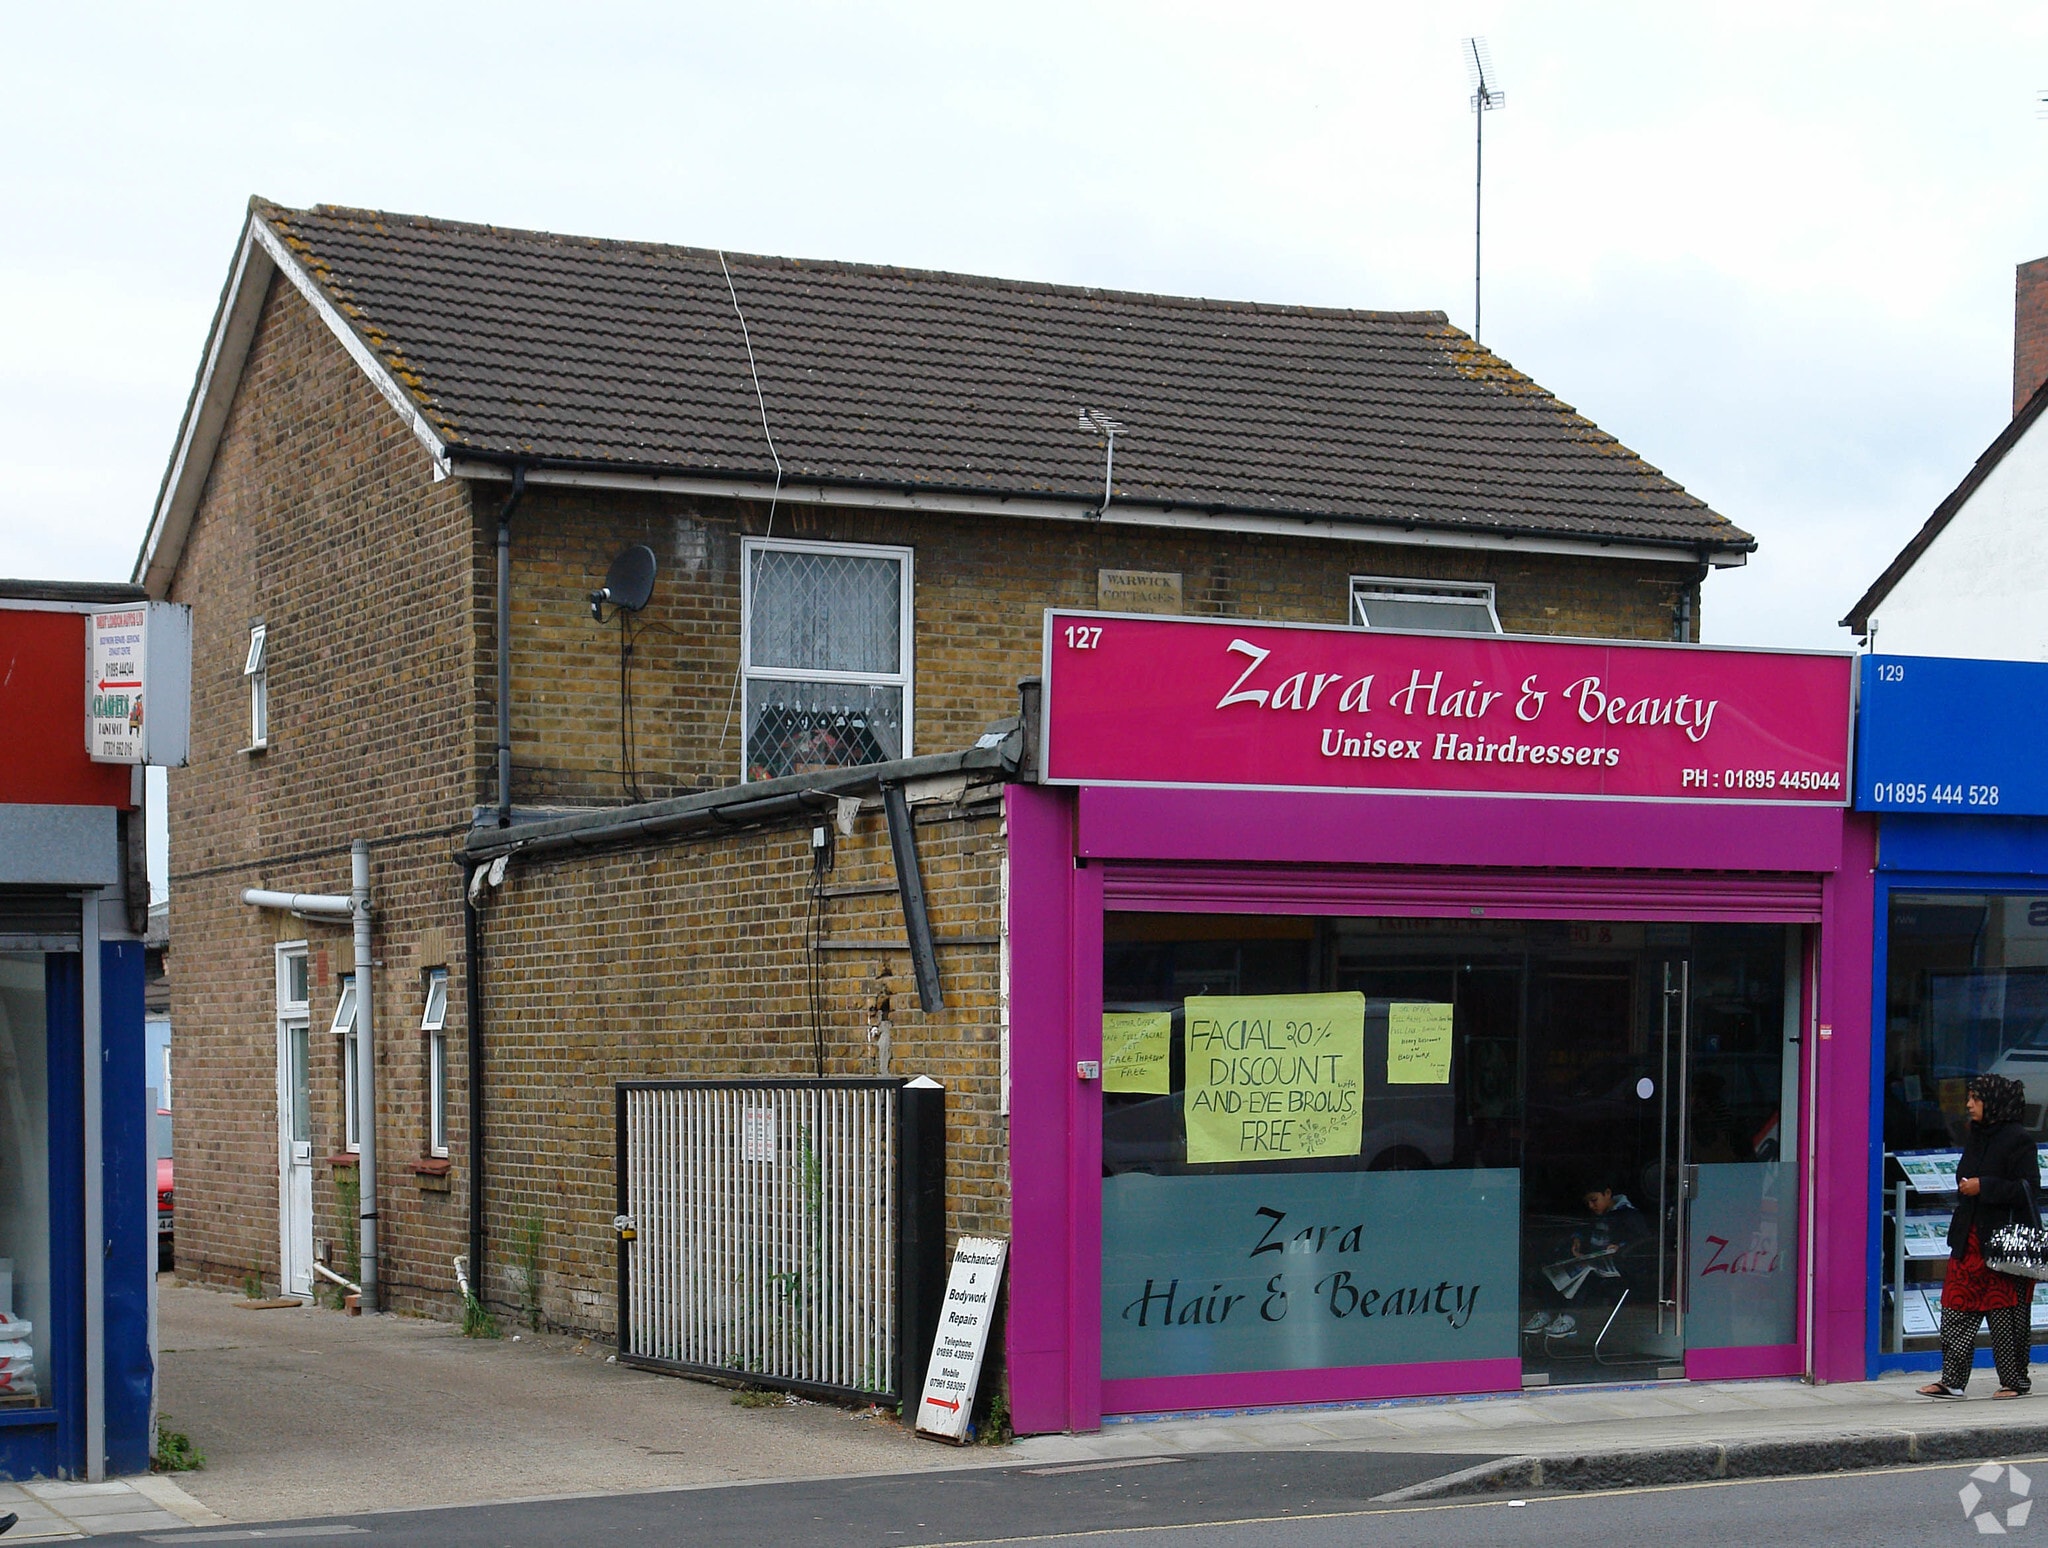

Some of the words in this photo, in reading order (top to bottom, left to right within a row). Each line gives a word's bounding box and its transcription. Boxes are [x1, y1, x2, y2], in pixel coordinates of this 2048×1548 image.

[1107, 575, 1171, 588] WARWICK
[1103, 589, 1175, 603] COTTAGES
[1065, 626, 1102, 649] 127
[1877, 664, 1905, 682] 129
[1216, 639, 1375, 712] Zara
[1389, 669, 1503, 718] Hair
[1515, 674, 1548, 721] &
[1563, 676, 1719, 742] Beauty
[1320, 729, 1422, 759] Unisex
[1432, 733, 1620, 767] Hairdressers
[1682, 769, 1708, 788] PH
[1724, 769, 1776, 789] 01895
[1780, 770, 1841, 790] 445044
[1874, 782, 1927, 803] 01895
[1932, 784, 1963, 804] 444
[1969, 786, 1999, 805] 528
[1191, 1020, 1286, 1052] FACIAL
[1286, 1020, 1332, 1048] 20%
[1120, 1066, 1147, 1078] FREE
[1210, 1055, 1343, 1087] DISCOUNT
[1288, 1090, 1356, 1113] BROWS
[1240, 1119, 1296, 1152] FREE
[1249, 1206, 1364, 1258] Zara
[955, 1251, 1000, 1265] Mechanical
[1700, 1235, 1785, 1277] Zara
[969, 1273, 977, 1284] &
[949, 1289, 987, 1304] Bodywork
[1122, 1279, 1246, 1327] Hair
[1260, 1273, 1295, 1322] &
[1314, 1270, 1480, 1329] Beauty
[948, 1311, 978, 1326] Repairs
[936, 1347, 953, 1358] 01895
[945, 1336, 972, 1348] Telephone
[942, 1367, 960, 1378] Mobile
